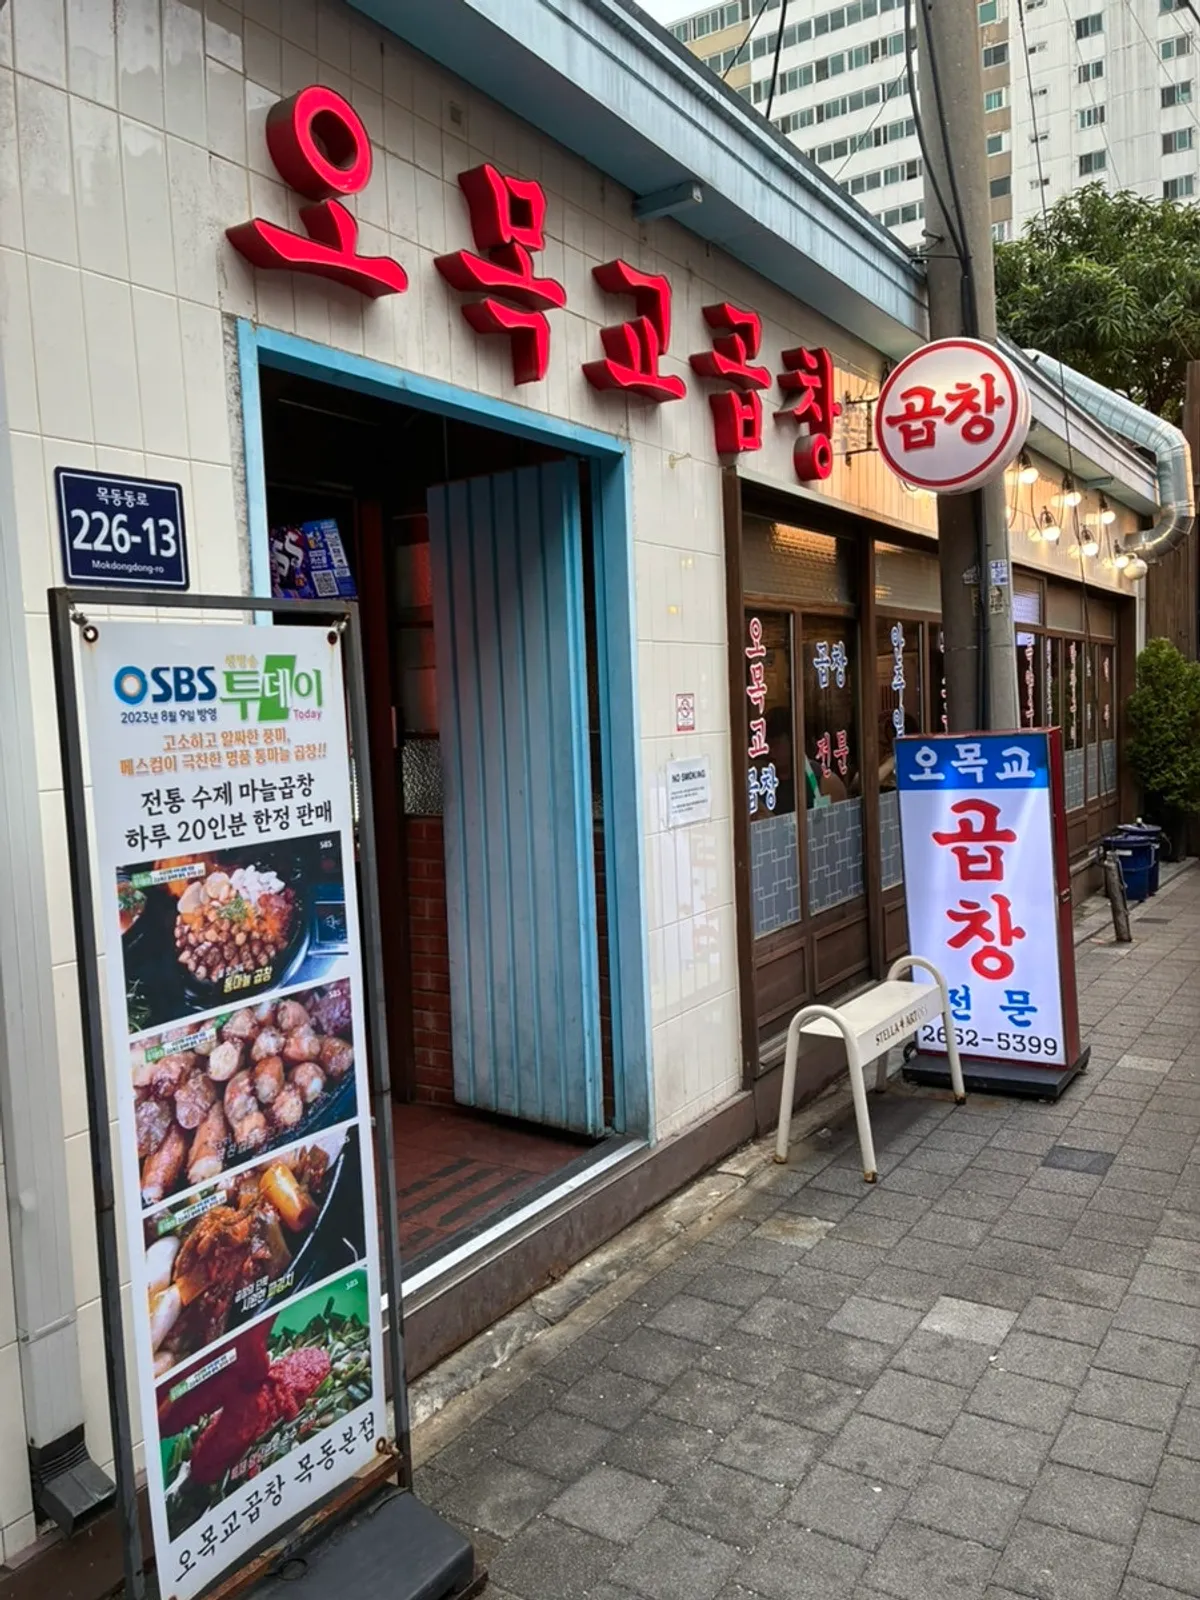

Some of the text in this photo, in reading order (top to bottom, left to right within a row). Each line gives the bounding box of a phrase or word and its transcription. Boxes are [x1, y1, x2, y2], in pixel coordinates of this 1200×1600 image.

[225, 84, 841, 480] 오목교곱창
[885, 372, 1006, 453] 곱창
[96, 487, 150, 508] 목동동로
[70, 508, 177, 558] 226-13
[91, 560, 165, 575] Mokdongdong-ro
[150, 666, 218, 703] SBS
[813, 640, 848, 689] 곱창
[219, 667, 323, 721] 투데이
[745, 617, 769, 759] 오목교
[120, 707, 218, 724] 2023년 8월 9일 방영
[292, 708, 322, 721] Today
[162, 726, 291, 751] 고소하고 알싸한 풍미,
[181, 751, 222, 772] 극찬한
[225, 749, 251, 769] 명품
[254, 746, 291, 766] 통마늘
[294, 741, 328, 761] 곱창!!
[908, 743, 1036, 783] 오목교
[140, 772, 316, 817] 전통 수제 마늘곱창
[125, 799, 333, 853] 하루 20인분 한정 판매
[931, 798, 1027, 980] 곱창
[948, 984, 1038, 1028] 전문
[875, 1022, 900, 1046] STELLA
[175, 1475, 286, 1582] 오목교곱창
[293, 1411, 376, 1484] 목동본점
